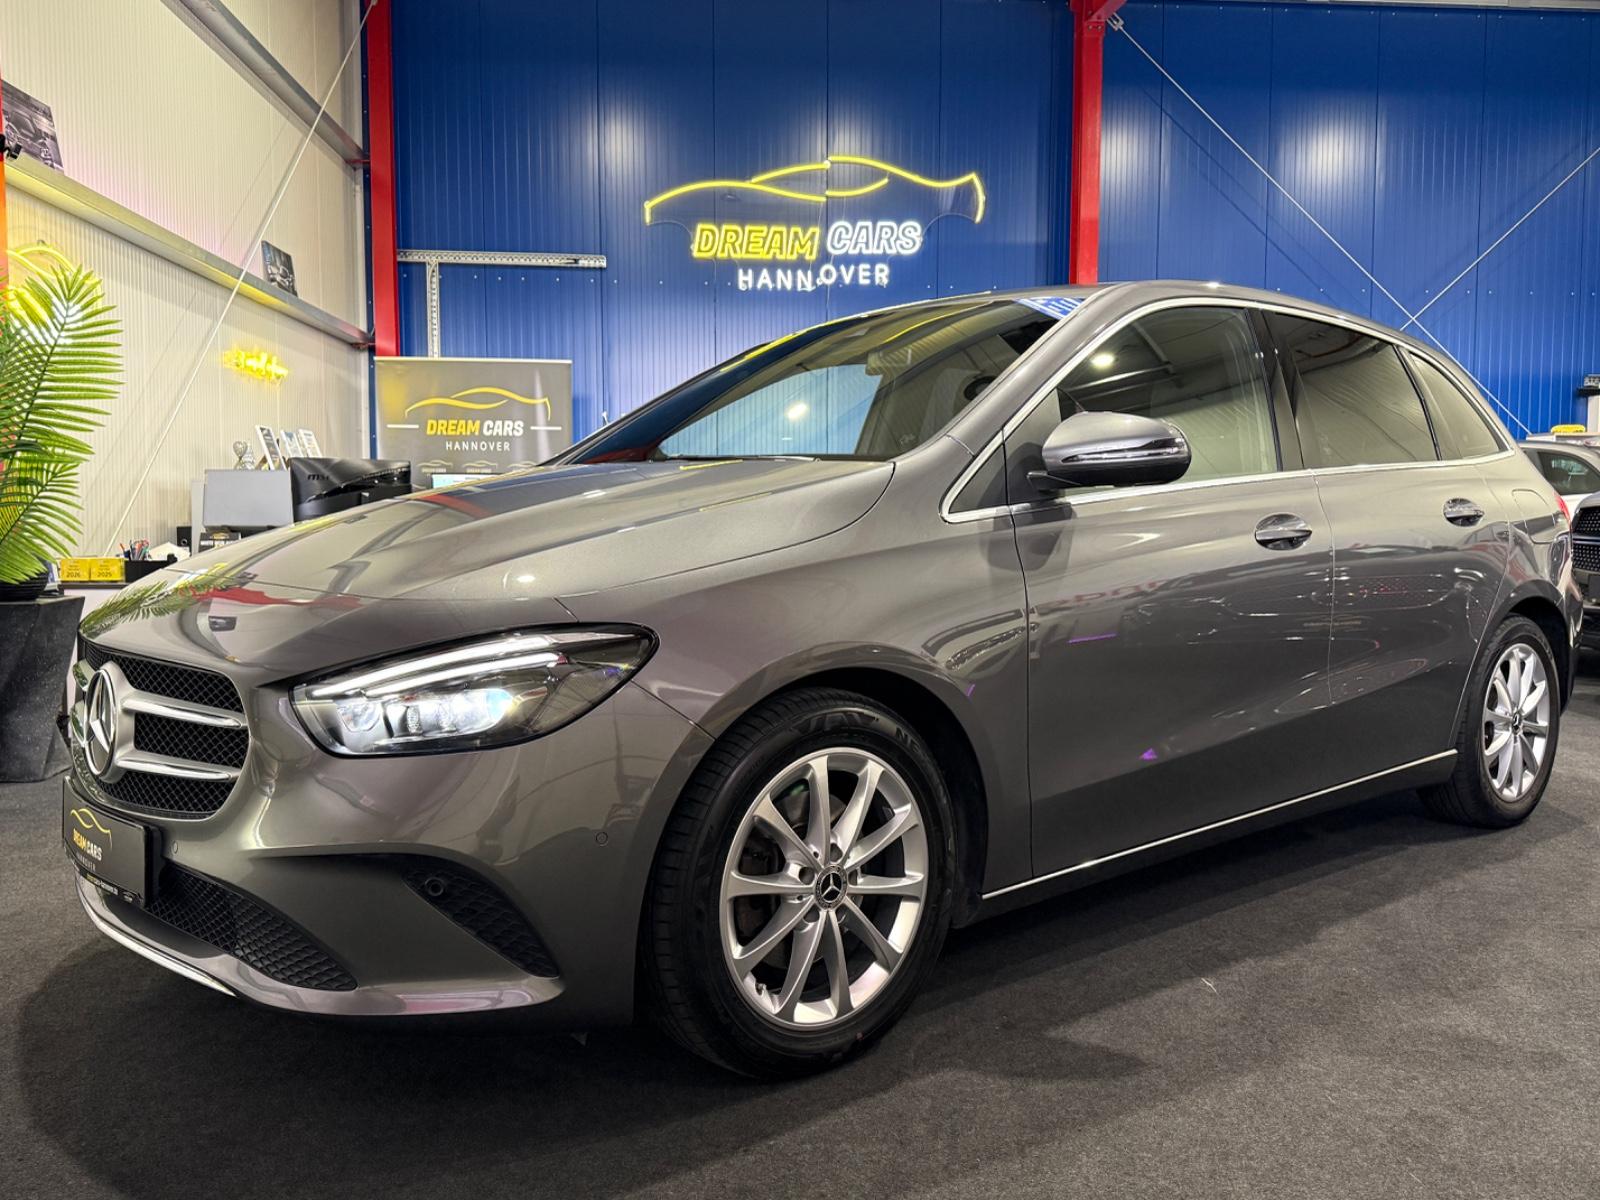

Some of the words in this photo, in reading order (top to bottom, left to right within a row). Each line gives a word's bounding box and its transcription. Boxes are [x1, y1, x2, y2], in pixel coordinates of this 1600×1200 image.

[692, 223, 820, 260] DREAM
[827, 221, 923, 254] CARS
[737, 263, 890, 291] HANNOVER
[426, 419, 481, 436] DREAM
[482, 420, 525, 437] CARS
[445, 441, 511, 451] HANNOVER
